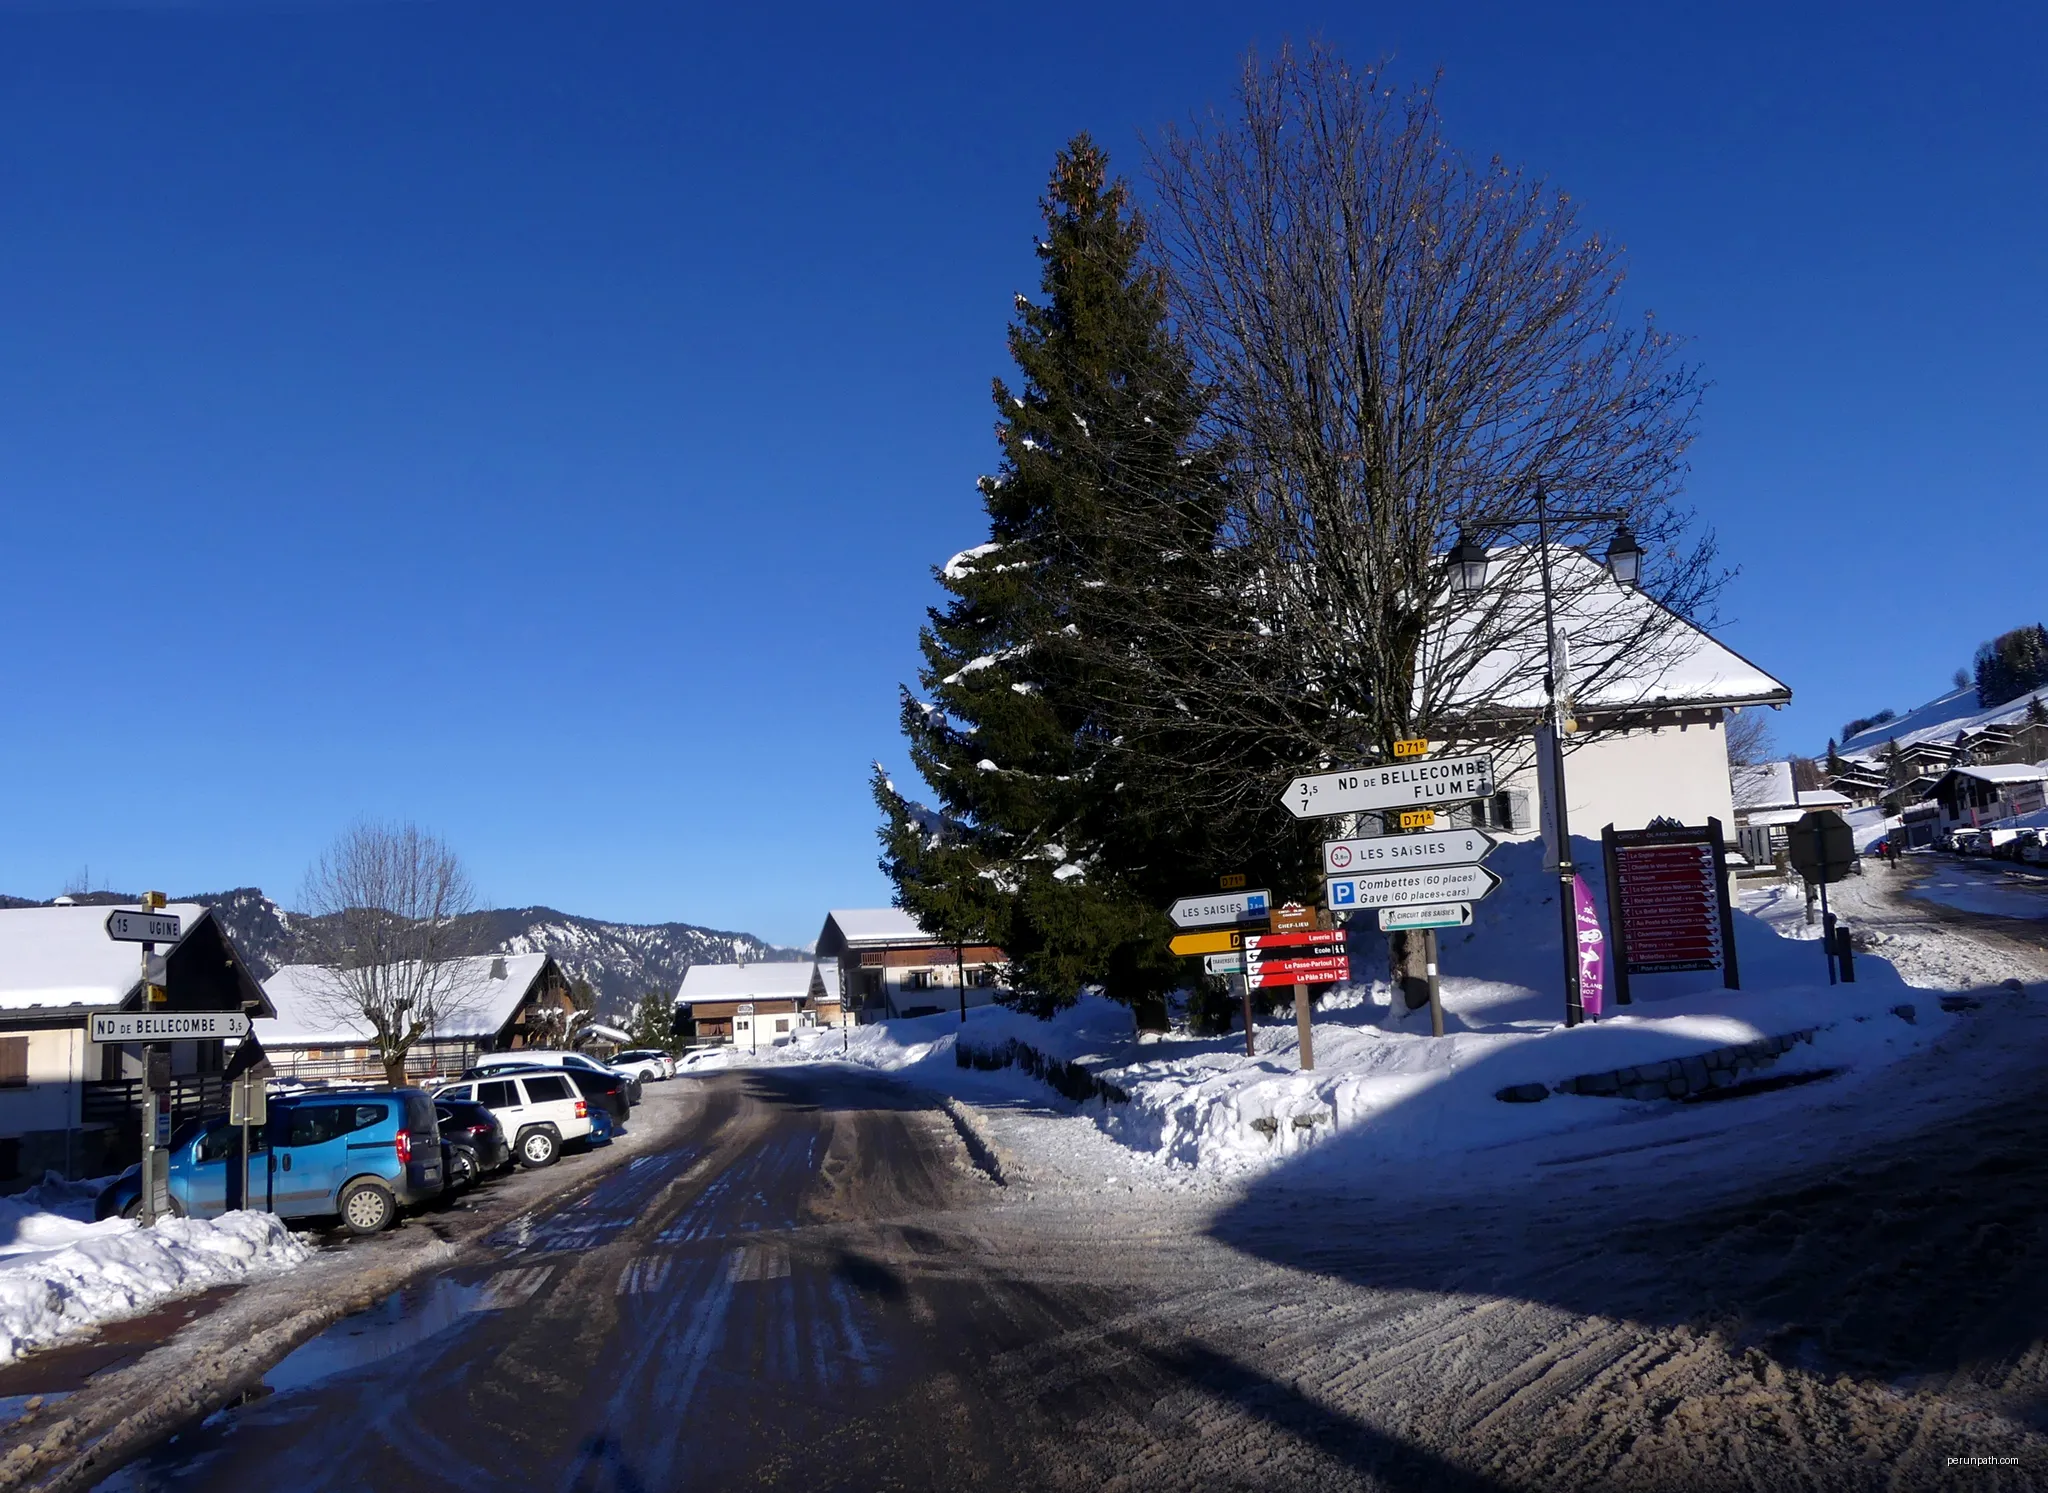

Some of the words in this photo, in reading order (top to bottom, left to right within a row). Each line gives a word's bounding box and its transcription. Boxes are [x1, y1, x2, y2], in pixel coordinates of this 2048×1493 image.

[1397, 742, 1425, 754] D71B
[1338, 777, 1359, 791] ND
[1363, 778, 1376, 788] DE
[1381, 760, 1486, 785] BELLECOMBE
[1300, 783, 1319, 796] 3,5
[1414, 778, 1487, 798] FLUMET
[1301, 799, 1309, 812] 7
[1403, 813, 1432, 826] D71A
[1360, 848, 1384, 860] LES
[1465, 840, 1473, 851] 8
[1359, 877, 1420, 890] Combettes
[1423, 875, 1440, 885] (60
[1442, 872, 1477, 885] places)
[1360, 891, 1389, 903] Gave
[1392, 891, 1408, 901] (60
[1182, 907, 1200, 918] LES
[1203, 903, 1242, 916] SAISIES
[1397, 911, 1419, 919] CIRCUIT
[1420, 909, 1432, 918] DES
[1433, 908, 1455, 917] SAISIES
[117, 918, 128, 933] 15
[150, 921, 178, 936] UGINE
[1278, 921, 1309, 929] CHEF-LIEU
[1308, 934, 1331, 942] Laverie
[1314, 946, 1331, 954] Ecole
[1293, 960, 1333, 969] Passe-Partout
[97, 1020, 115, 1035] ND
[121, 1024, 131, 1034] DE
[136, 1018, 216, 1034] BELLECOMBE
[229, 1018, 243, 1034] 3,5
